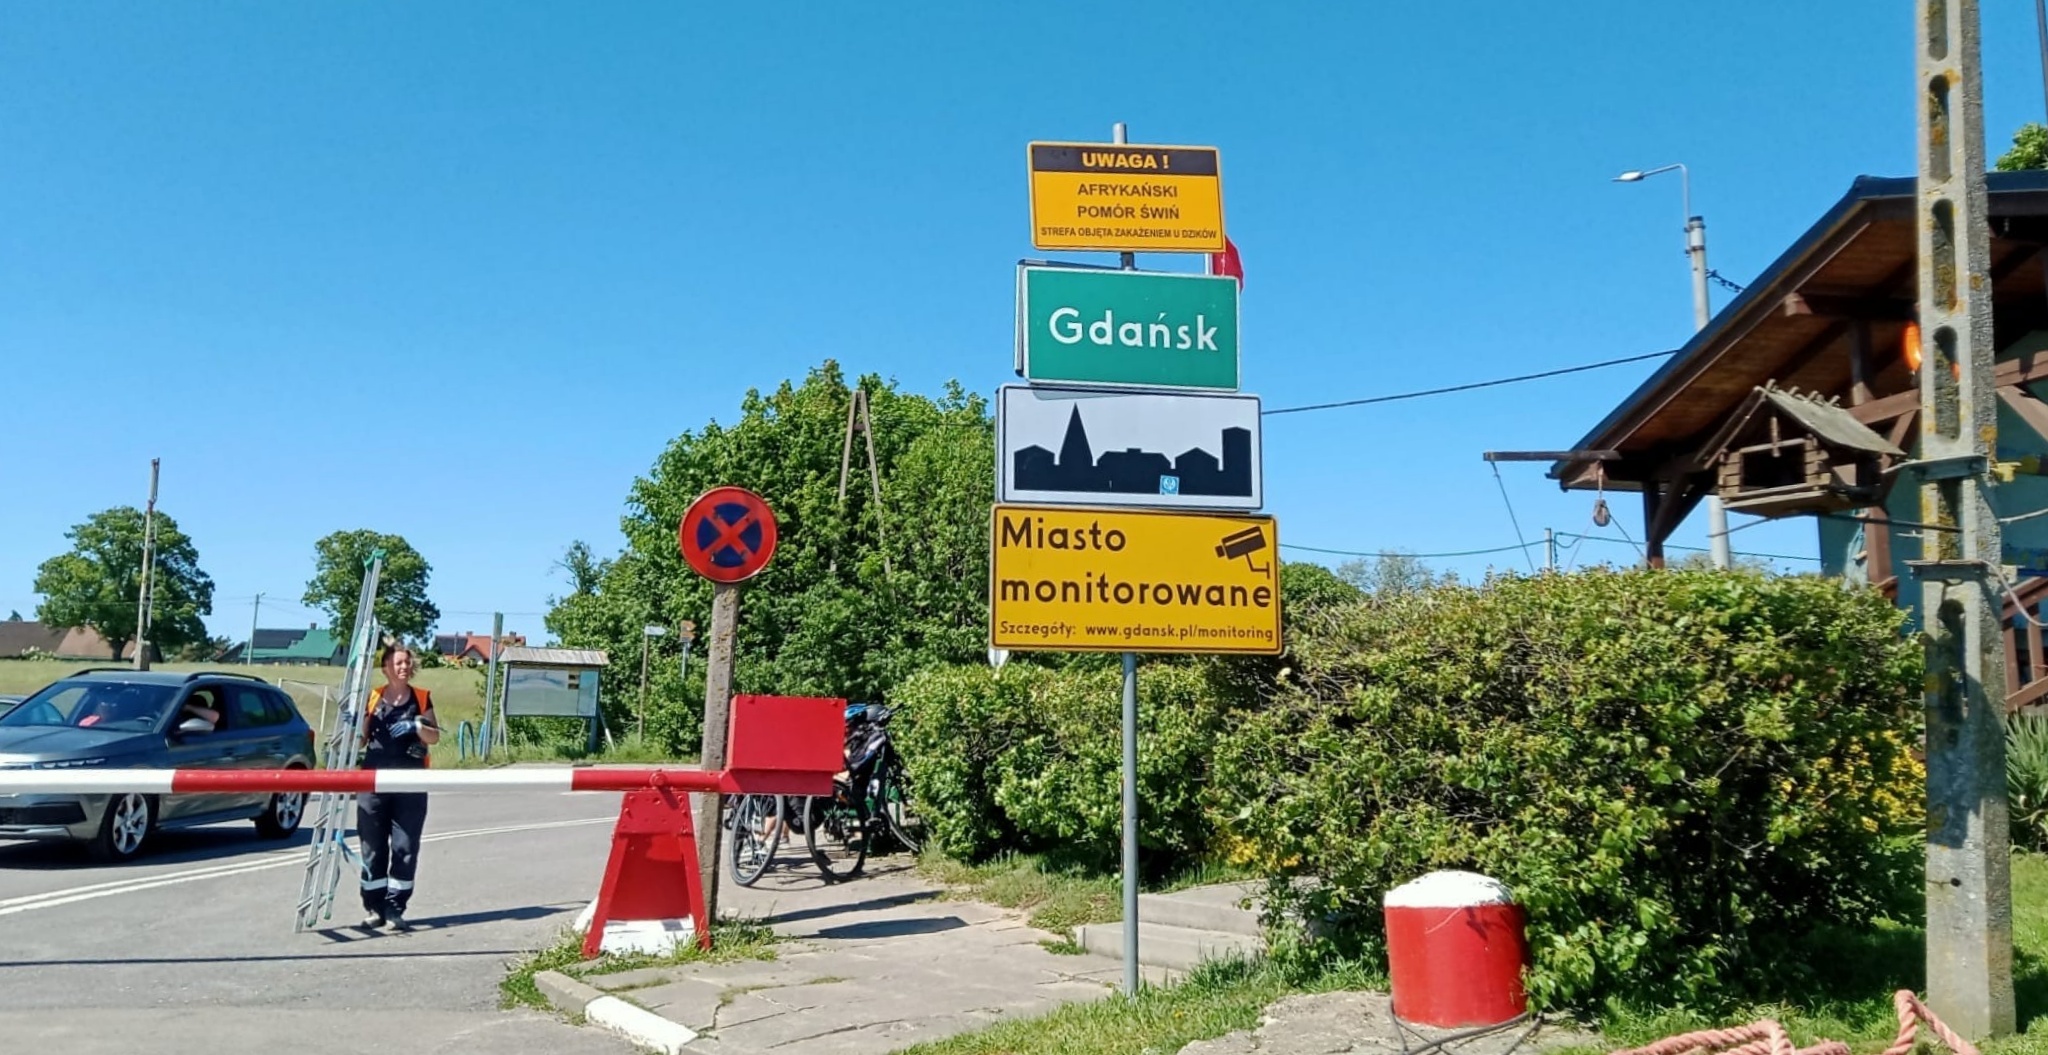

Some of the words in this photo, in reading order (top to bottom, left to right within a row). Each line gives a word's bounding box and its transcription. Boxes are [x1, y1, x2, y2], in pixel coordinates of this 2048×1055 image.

[1082, 152, 1157, 168] UWAGA
[1162, 155, 1169, 169] !
[1077, 181, 1178, 197] AFRYKAŃSKI
[1077, 204, 1135, 219] POMÓR
[1140, 204, 1180, 219] ŚWIŃ
[1041, 226, 1076, 236] STREFA
[1078, 227, 1113, 239] OBJĘTA
[1115, 228, 1172, 238] ZAKAŻENIEM
[1174, 229, 1180, 238] U
[1182, 228, 1217, 239] DZIKÓW
[1049, 307, 1219, 351] Gdańsk
[1001, 516, 1126, 551] Miasto
[1001, 572, 1272, 608] monitorowane
[1000, 621, 1077, 638] Szczegóły:
[1086, 624, 1273, 642] www.gdansk.pl/monitoring
